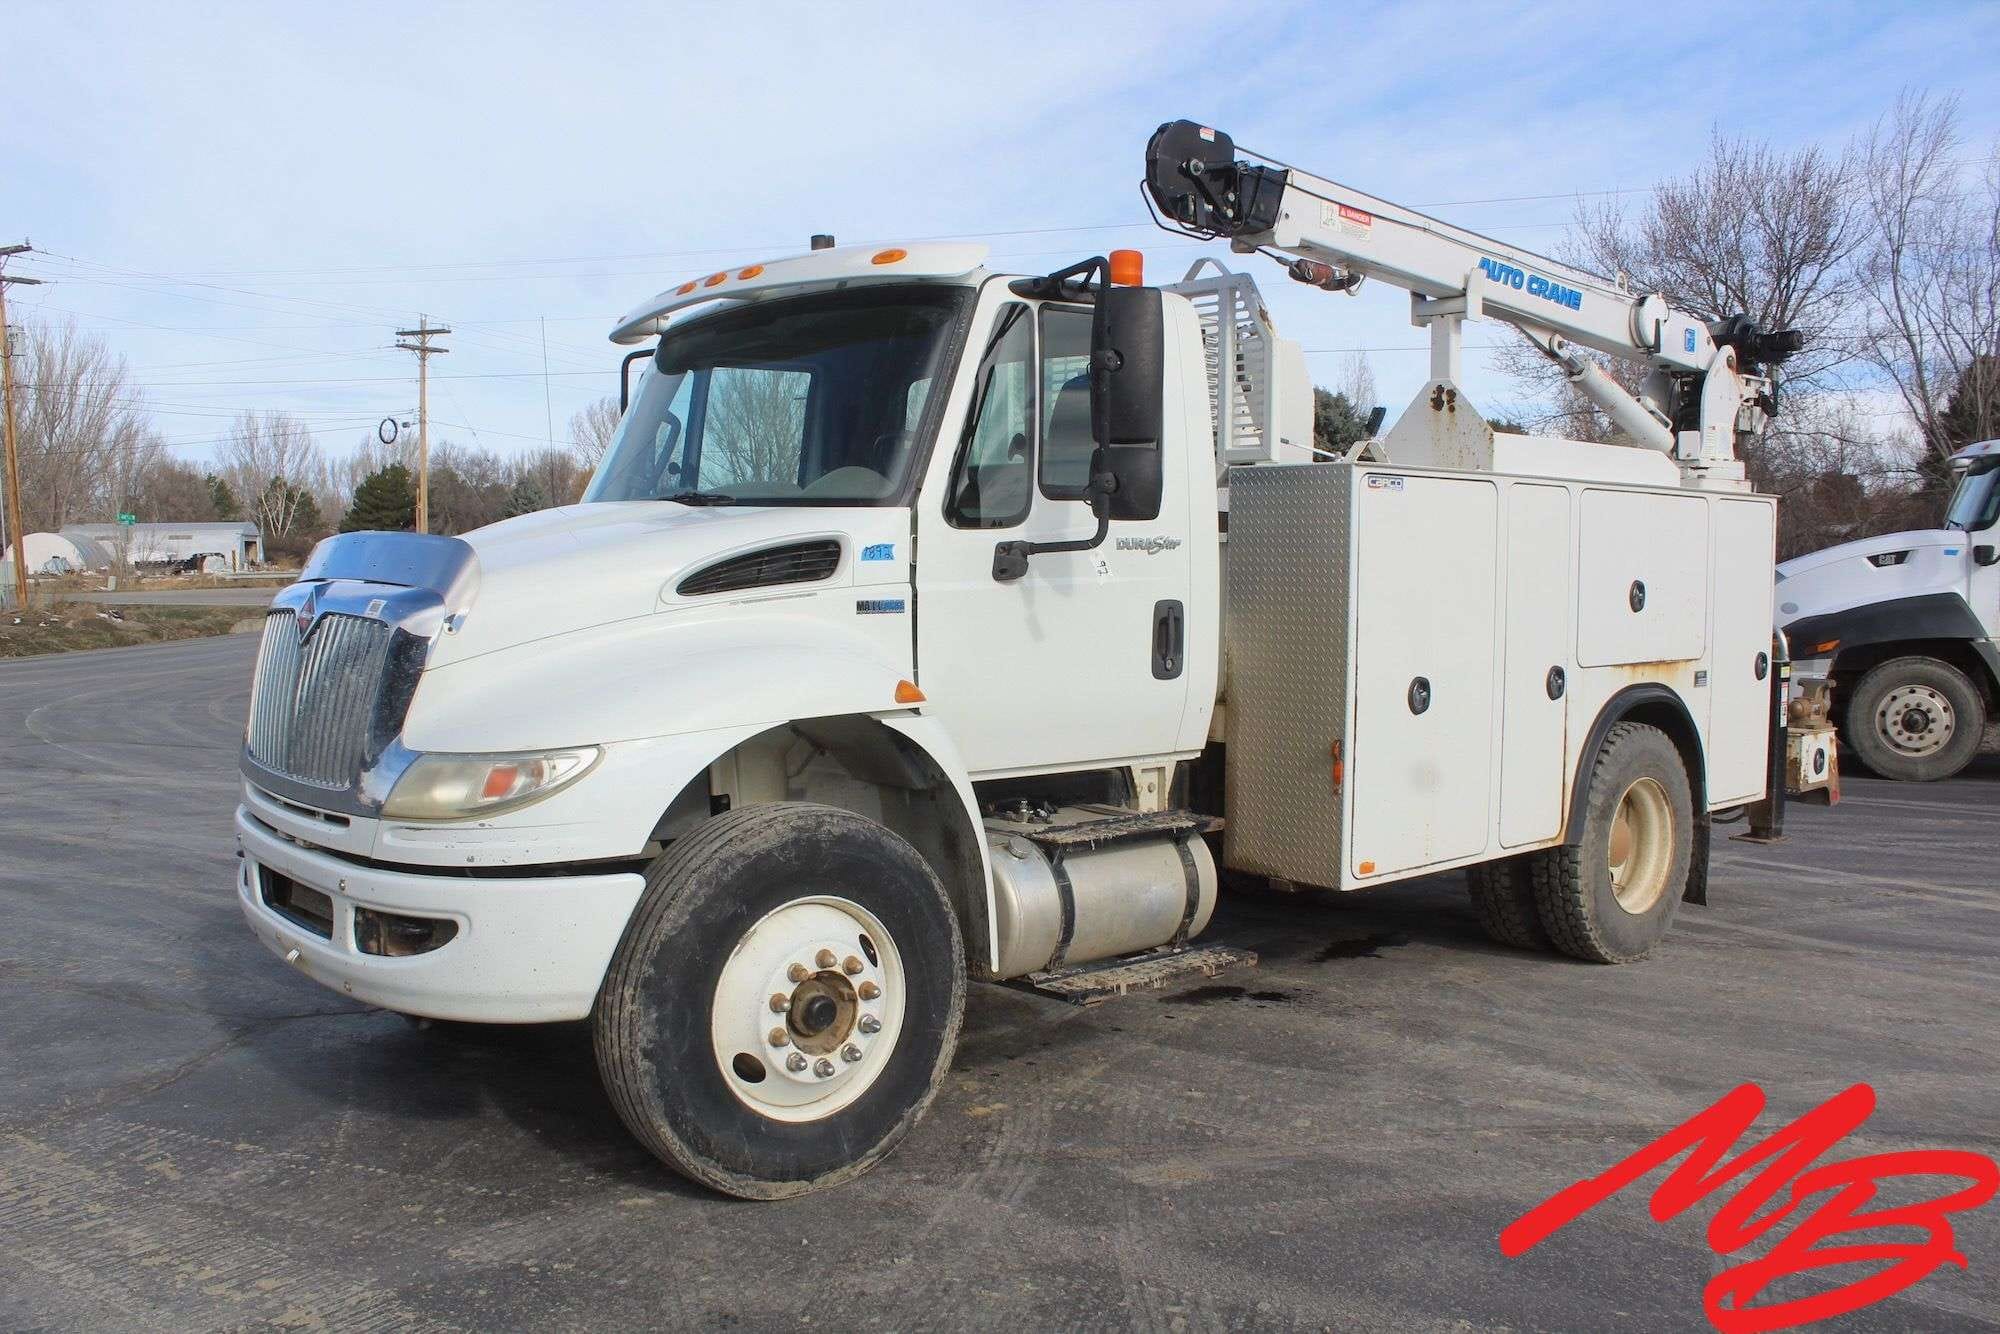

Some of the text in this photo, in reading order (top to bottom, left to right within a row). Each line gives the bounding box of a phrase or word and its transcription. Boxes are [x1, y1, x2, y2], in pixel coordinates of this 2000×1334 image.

[1478, 257, 1583, 311] AUTO CRANE
[1879, 554, 1896, 565] CAT
